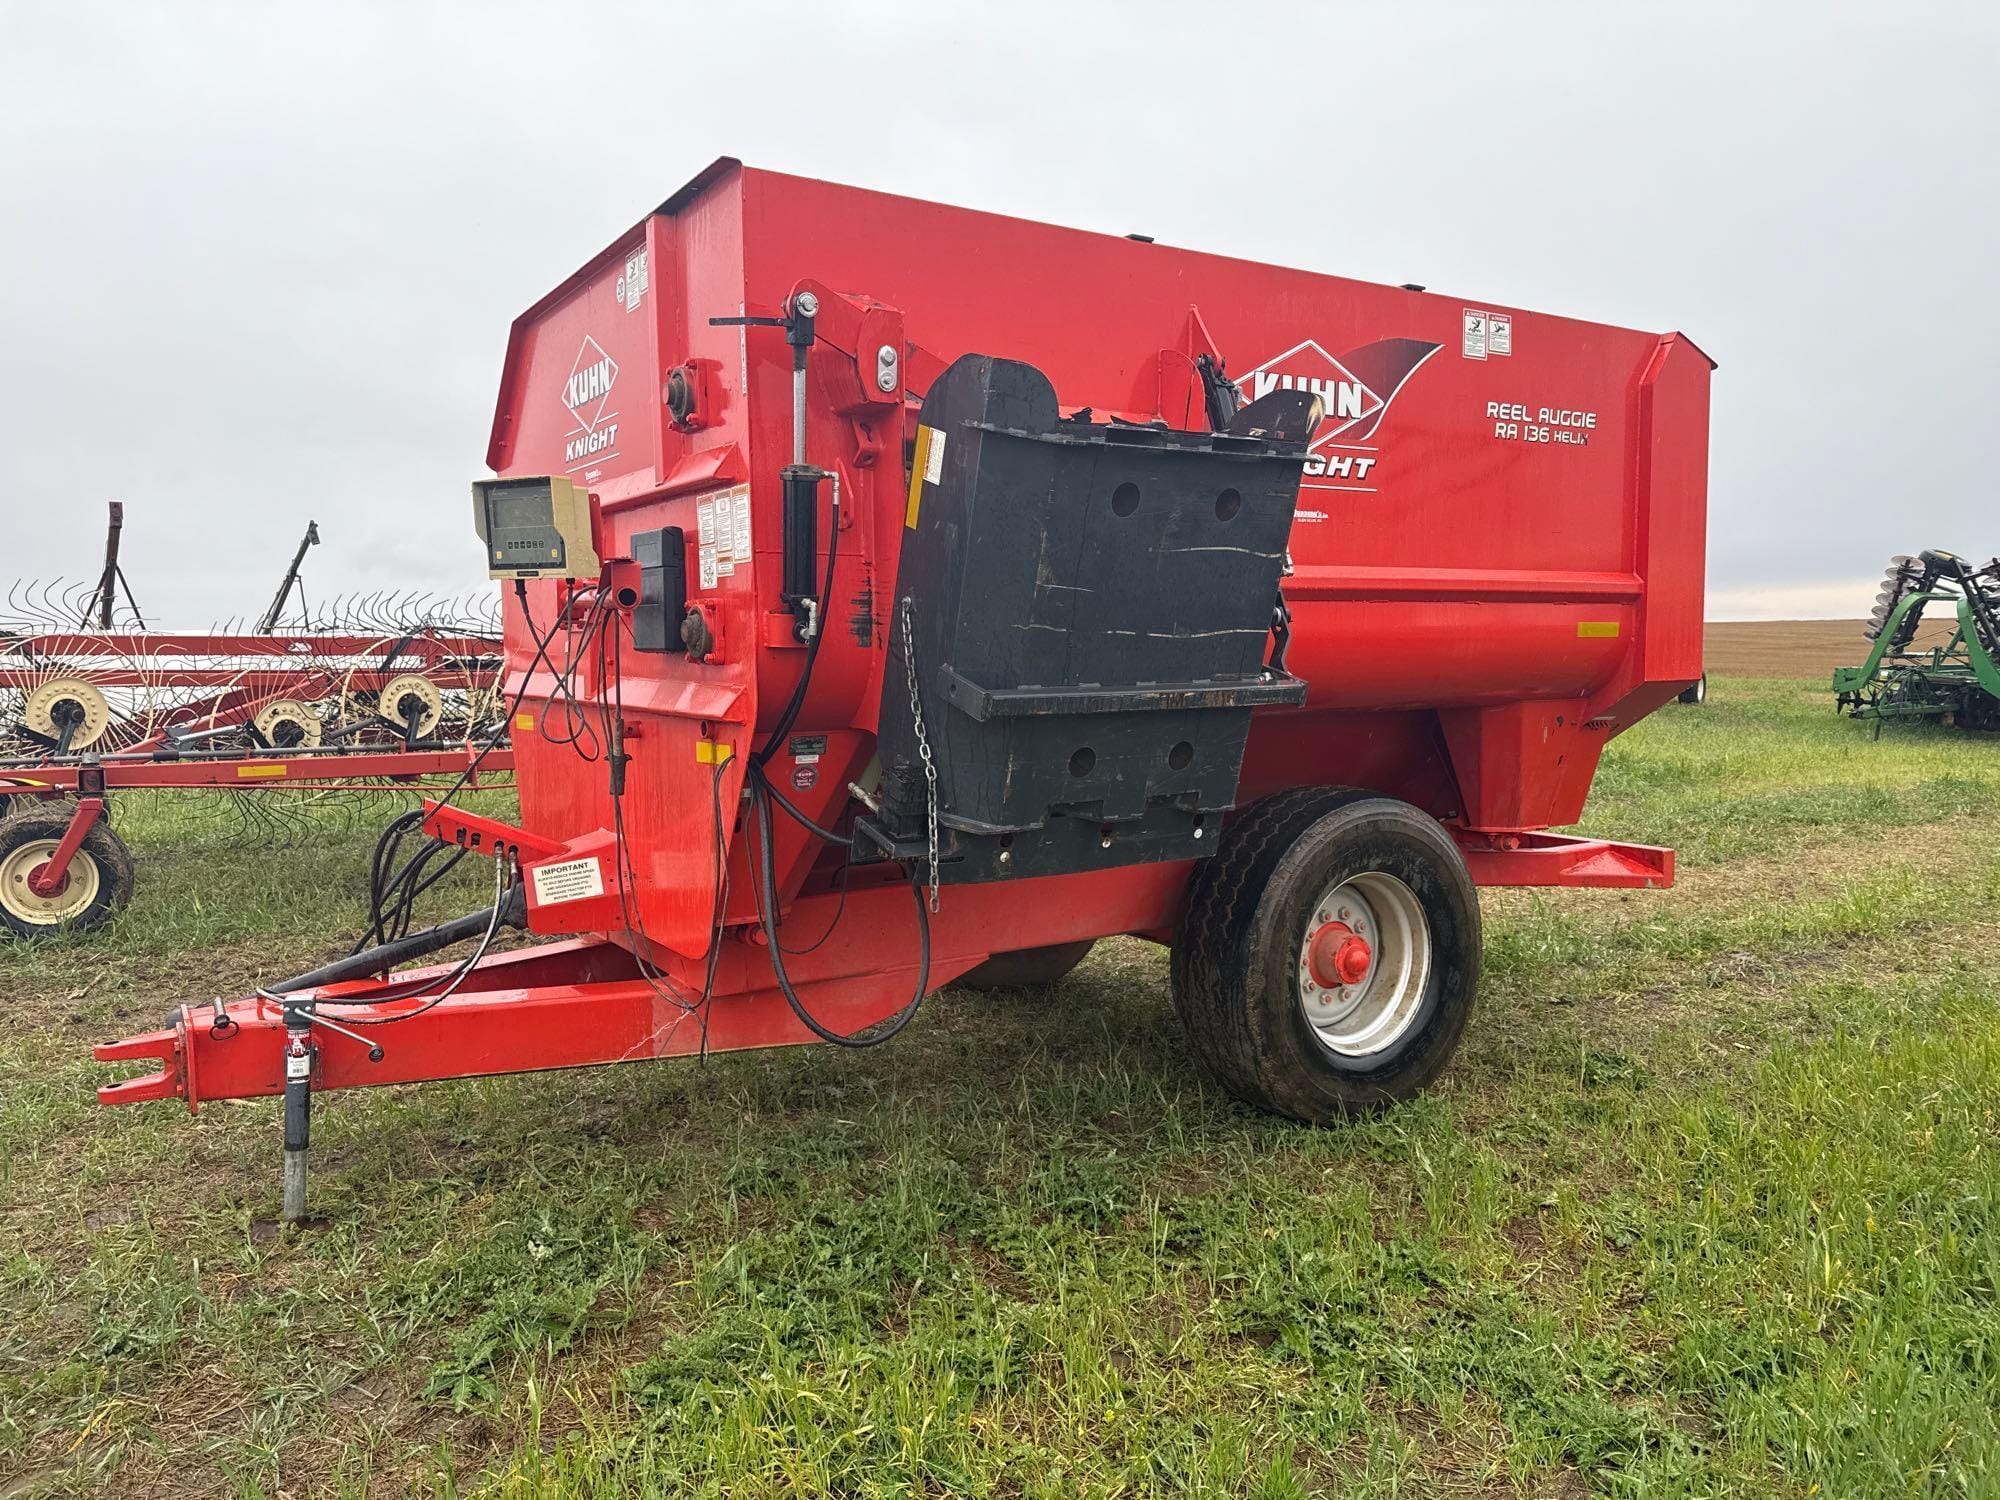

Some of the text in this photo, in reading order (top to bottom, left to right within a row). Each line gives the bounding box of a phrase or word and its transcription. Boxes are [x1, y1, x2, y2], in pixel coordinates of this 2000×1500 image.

[568, 358, 611, 410] KUHN
[1486, 401, 1597, 430] REEL AUGGIE
[565, 423, 619, 463] KNIGHT
[1494, 422, 1589, 446] RA 136 HELIX
[541, 862, 589, 876] IMPORTANT
